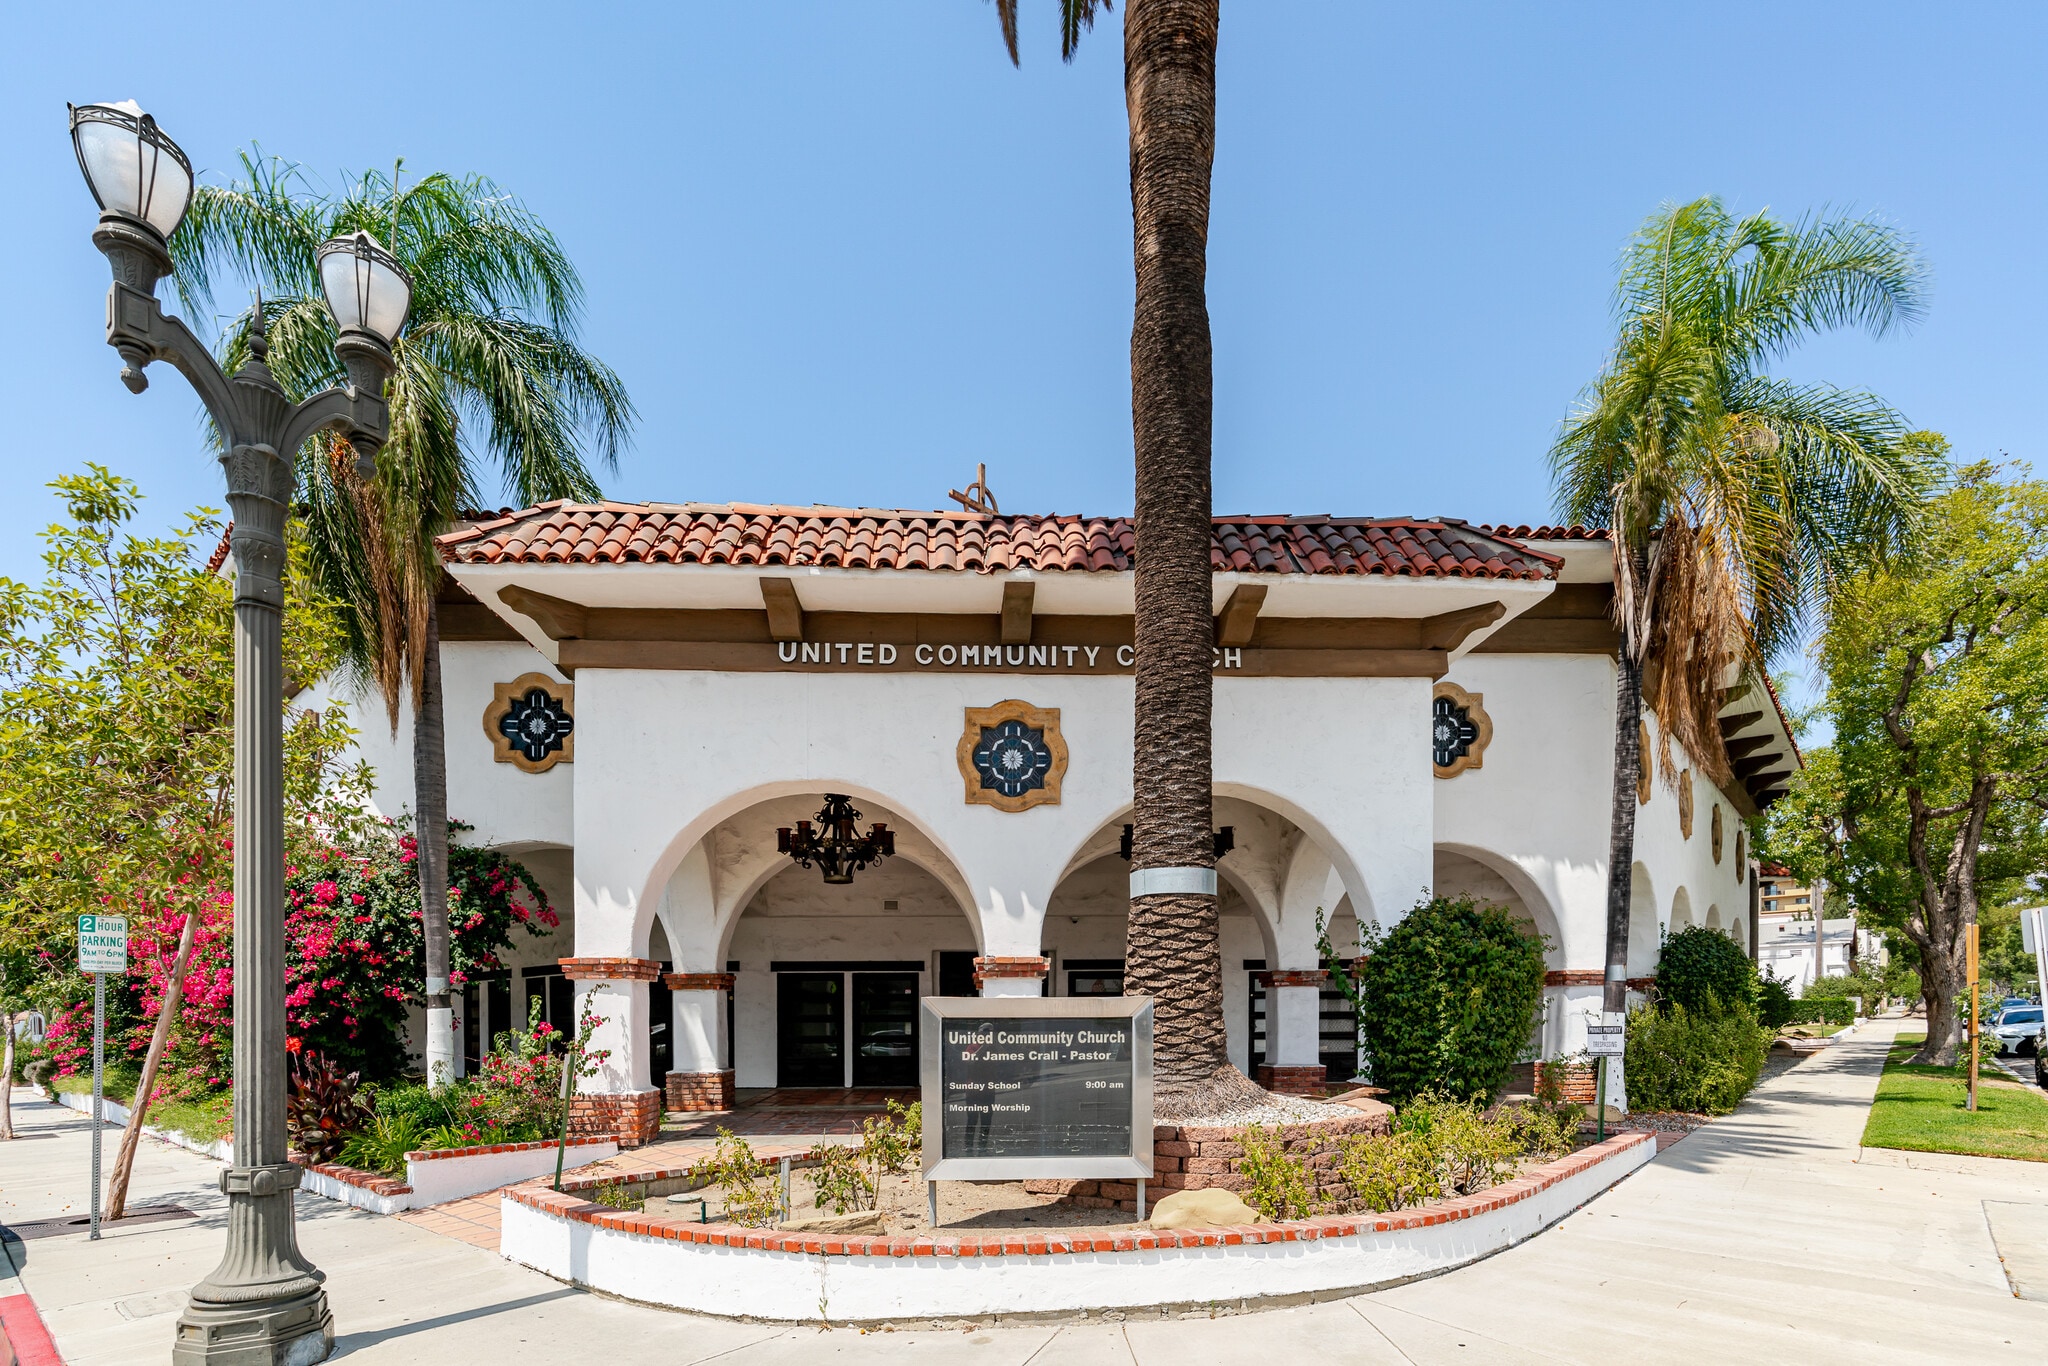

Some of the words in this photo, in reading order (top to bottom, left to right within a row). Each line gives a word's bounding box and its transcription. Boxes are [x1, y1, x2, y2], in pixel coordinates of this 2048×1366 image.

[778, 641, 897, 665] UNITED
[914, 643, 1100, 667] COMMUNITY
[82, 918, 92, 930] 2
[98, 922, 123, 931] HOUR
[82, 936, 123, 947] PARKING
[82, 948, 96, 956] 9AM
[106, 949, 123, 957] 6PM
[948, 1031, 994, 1045] United
[998, 1031, 1073, 1047] Community
[1077, 1030, 1126, 1044] Church
[961, 1051, 979, 1062] Dr.
[982, 1051, 1025, 1062] James
[1070, 1050, 1112, 1061] Pastor
[949, 1081, 985, 1091] Sunday
[987, 1081, 1021, 1090] School
[1085, 1081, 1107, 1089] 9:00
[949, 1104, 989, 1113] Morning
[991, 1103, 1031, 1113] Worship
